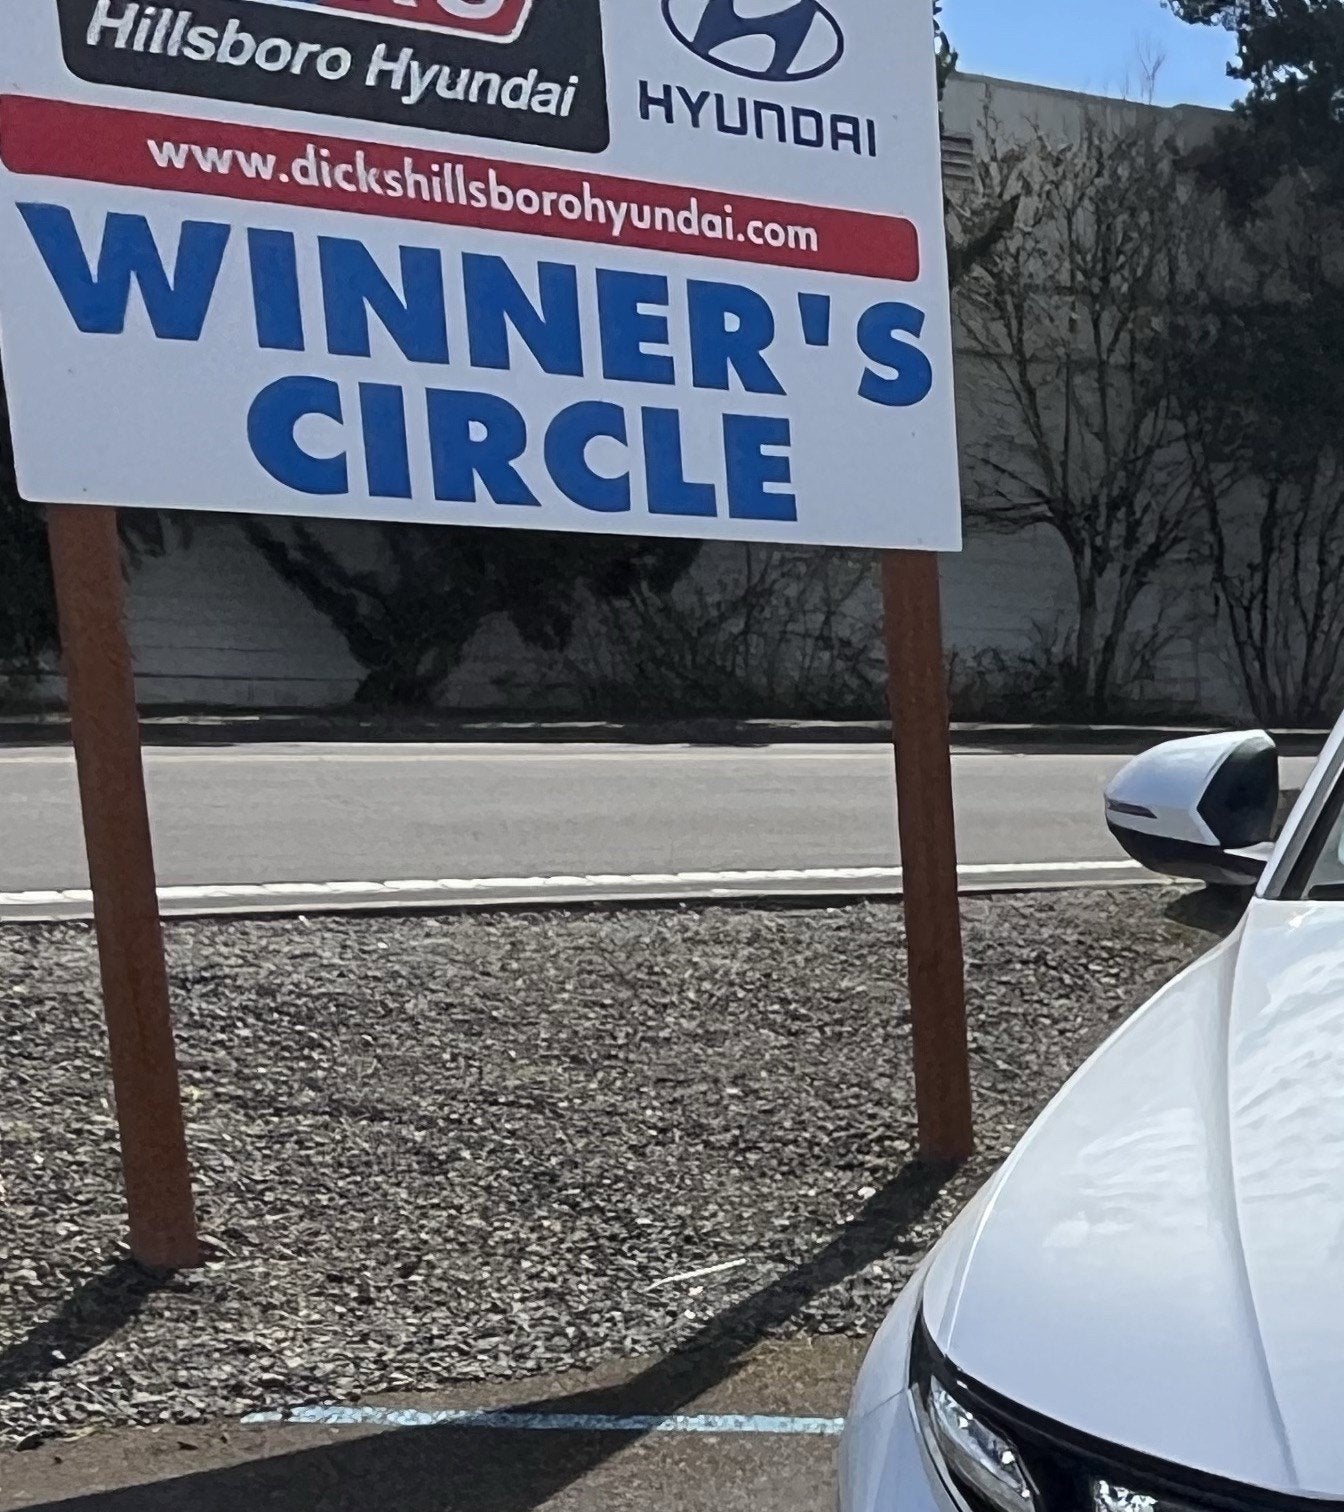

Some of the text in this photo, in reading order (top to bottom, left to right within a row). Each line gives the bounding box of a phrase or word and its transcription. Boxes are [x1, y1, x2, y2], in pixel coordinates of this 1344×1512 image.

[85, 0, 579, 119] Hillsboro Hyundai
[638, 79, 878, 157] HYUNDAI
[146, 134, 820, 253] www.dickshillsborohyundai.com
[15, 201, 934, 408] WINNER'S
[246, 374, 798, 522] CIRCLE
